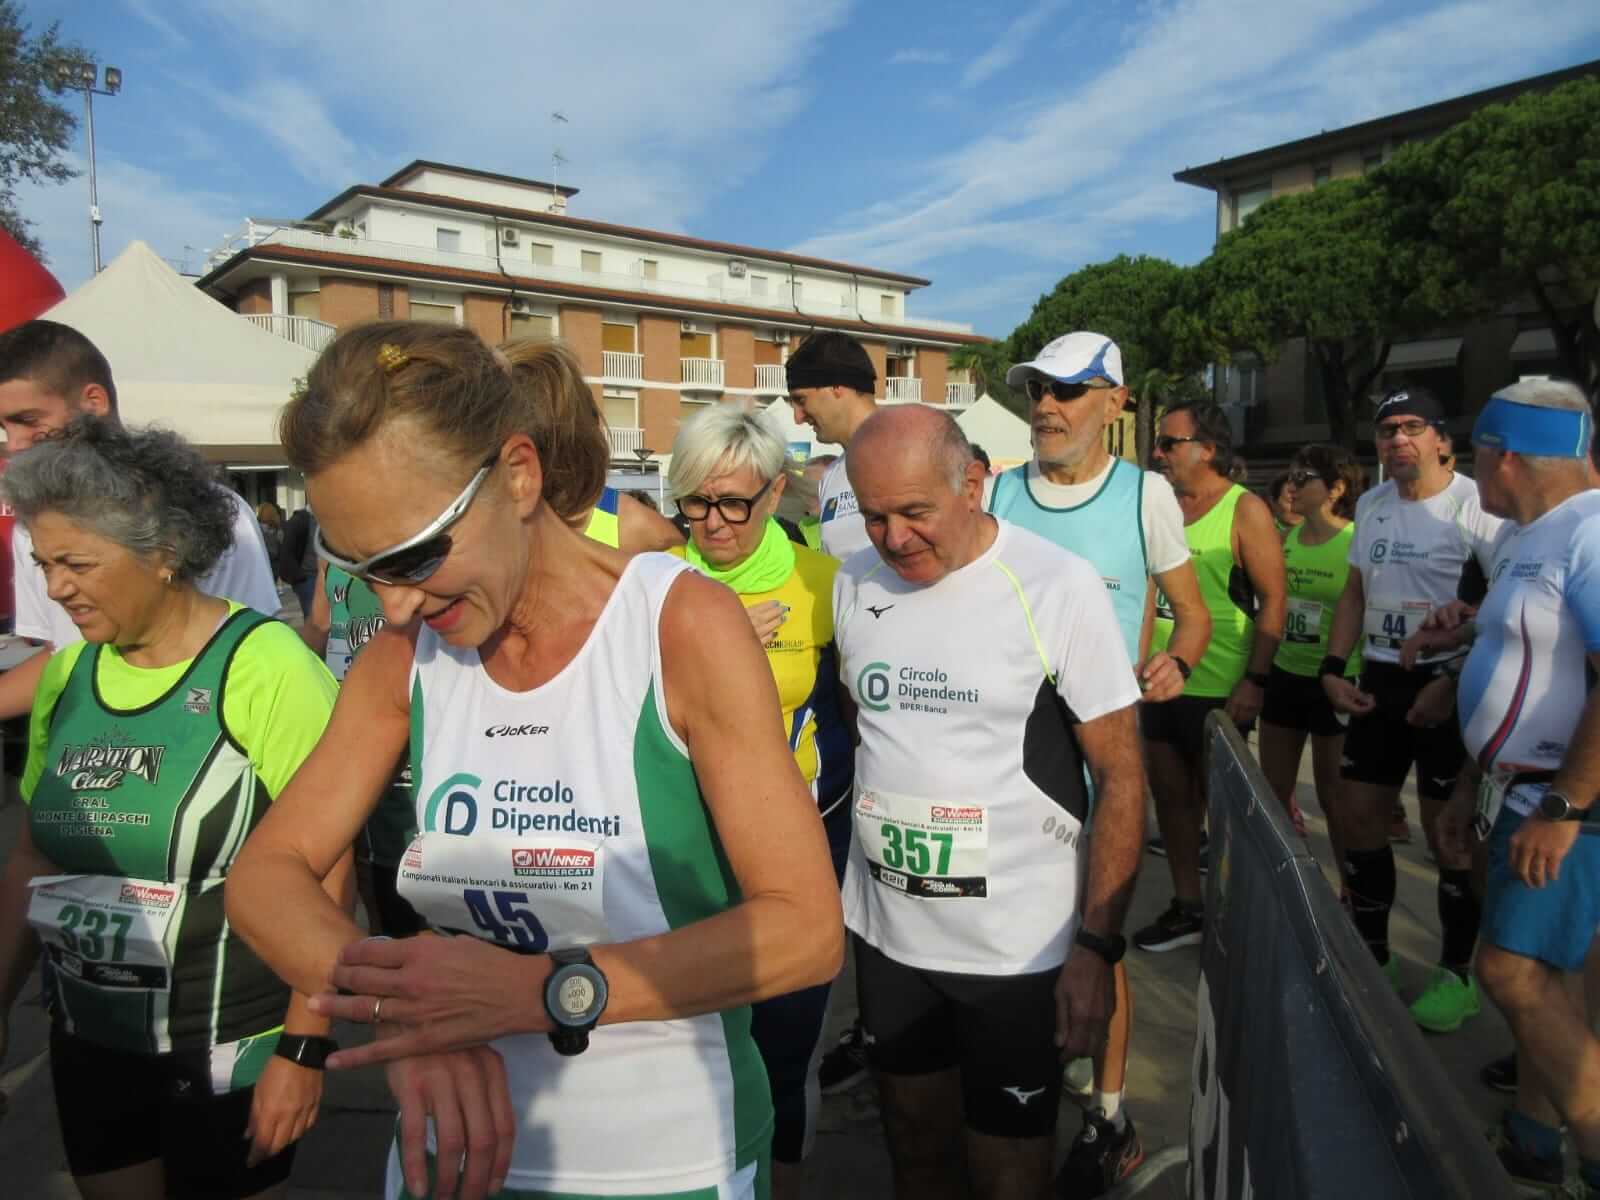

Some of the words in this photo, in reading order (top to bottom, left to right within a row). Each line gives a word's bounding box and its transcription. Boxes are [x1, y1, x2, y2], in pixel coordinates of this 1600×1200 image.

[1286, 611, 1307, 634] 06
[1382, 613, 1408, 637] 44
[899, 667, 948, 683] Circolo
[898, 683, 979, 704] Dipendenti
[57, 743, 165, 784] MARATHON
[72, 769, 124, 791] Club
[72, 797, 110, 809] CRAL
[494, 780, 574, 804] Circolo
[100, 812, 151, 825] PASCHI
[492, 808, 621, 837] Dipendenti
[536, 848, 592, 866] WINNER
[881, 823, 953, 875] 357
[402, 870, 441, 883] Campionati
[469, 876, 500, 887] bancari
[509, 880, 557, 890] assicurativi
[564, 881, 579, 891] Km
[581, 882, 592, 891] 21
[517, 868, 592, 877] SUPERMERCATI
[464, 889, 549, 955] 45
